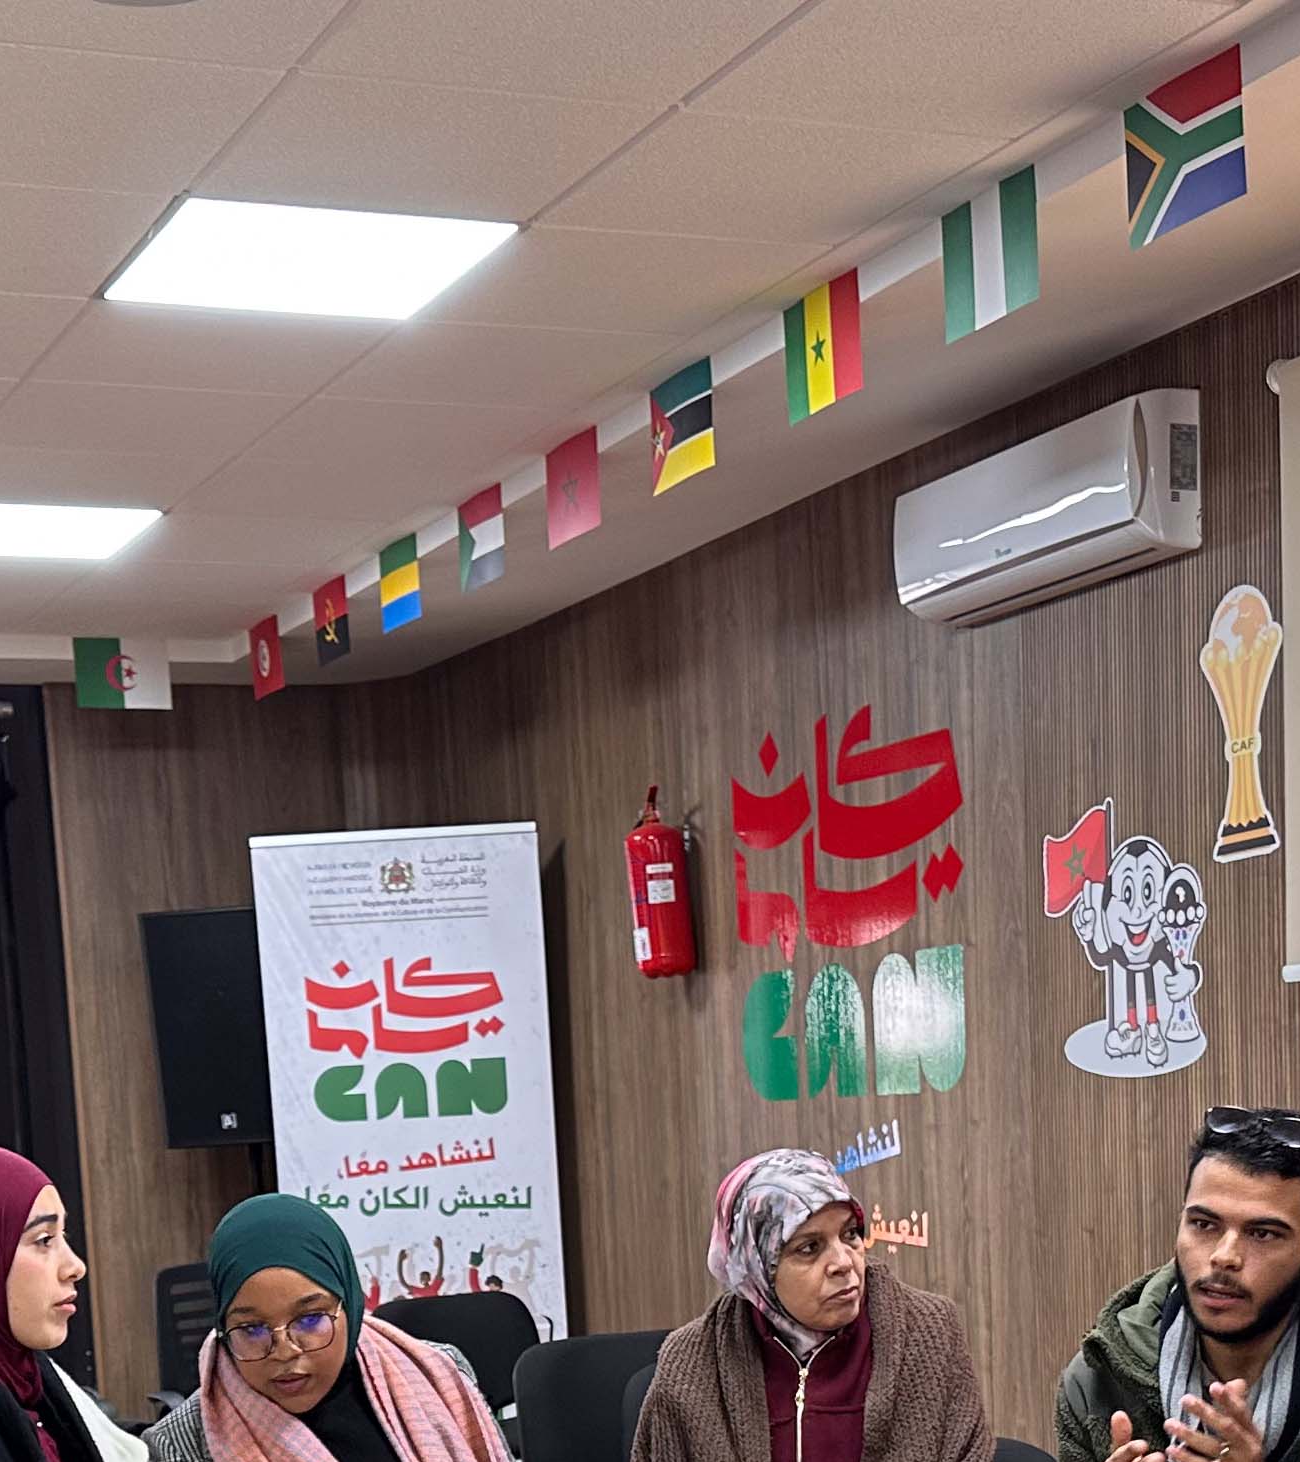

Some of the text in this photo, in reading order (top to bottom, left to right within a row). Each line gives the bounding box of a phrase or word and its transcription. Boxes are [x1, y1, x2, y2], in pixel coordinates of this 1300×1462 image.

[1231, 738, 1254, 753] CAF
[742, 943, 966, 1101] CAN
[313, 1057, 508, 1122] CAN
[398, 1137, 496, 1171] لنشاهد
[359, 1185, 429, 1217] الكان
[438, 1185, 532, 1217] لنعيش
